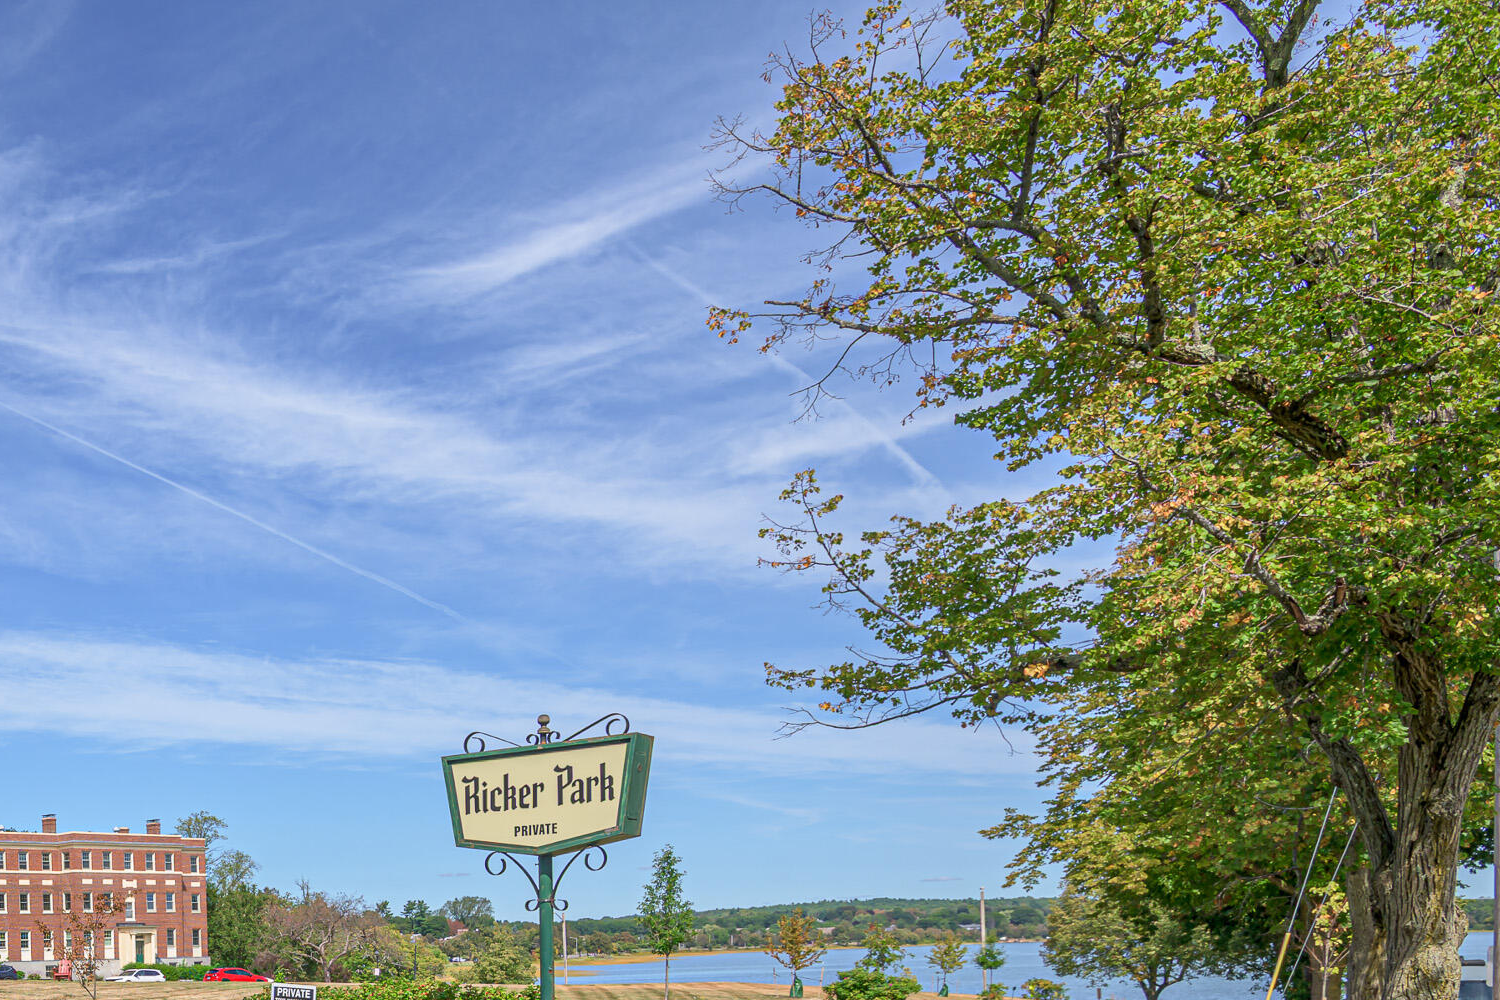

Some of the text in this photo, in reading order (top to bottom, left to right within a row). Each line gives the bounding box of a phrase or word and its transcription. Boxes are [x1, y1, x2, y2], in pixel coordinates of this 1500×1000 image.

[461, 762, 615, 815] Ricker Park
[514, 822, 558, 837] PRIVATE
[277, 988, 310, 998] PRIVATE
